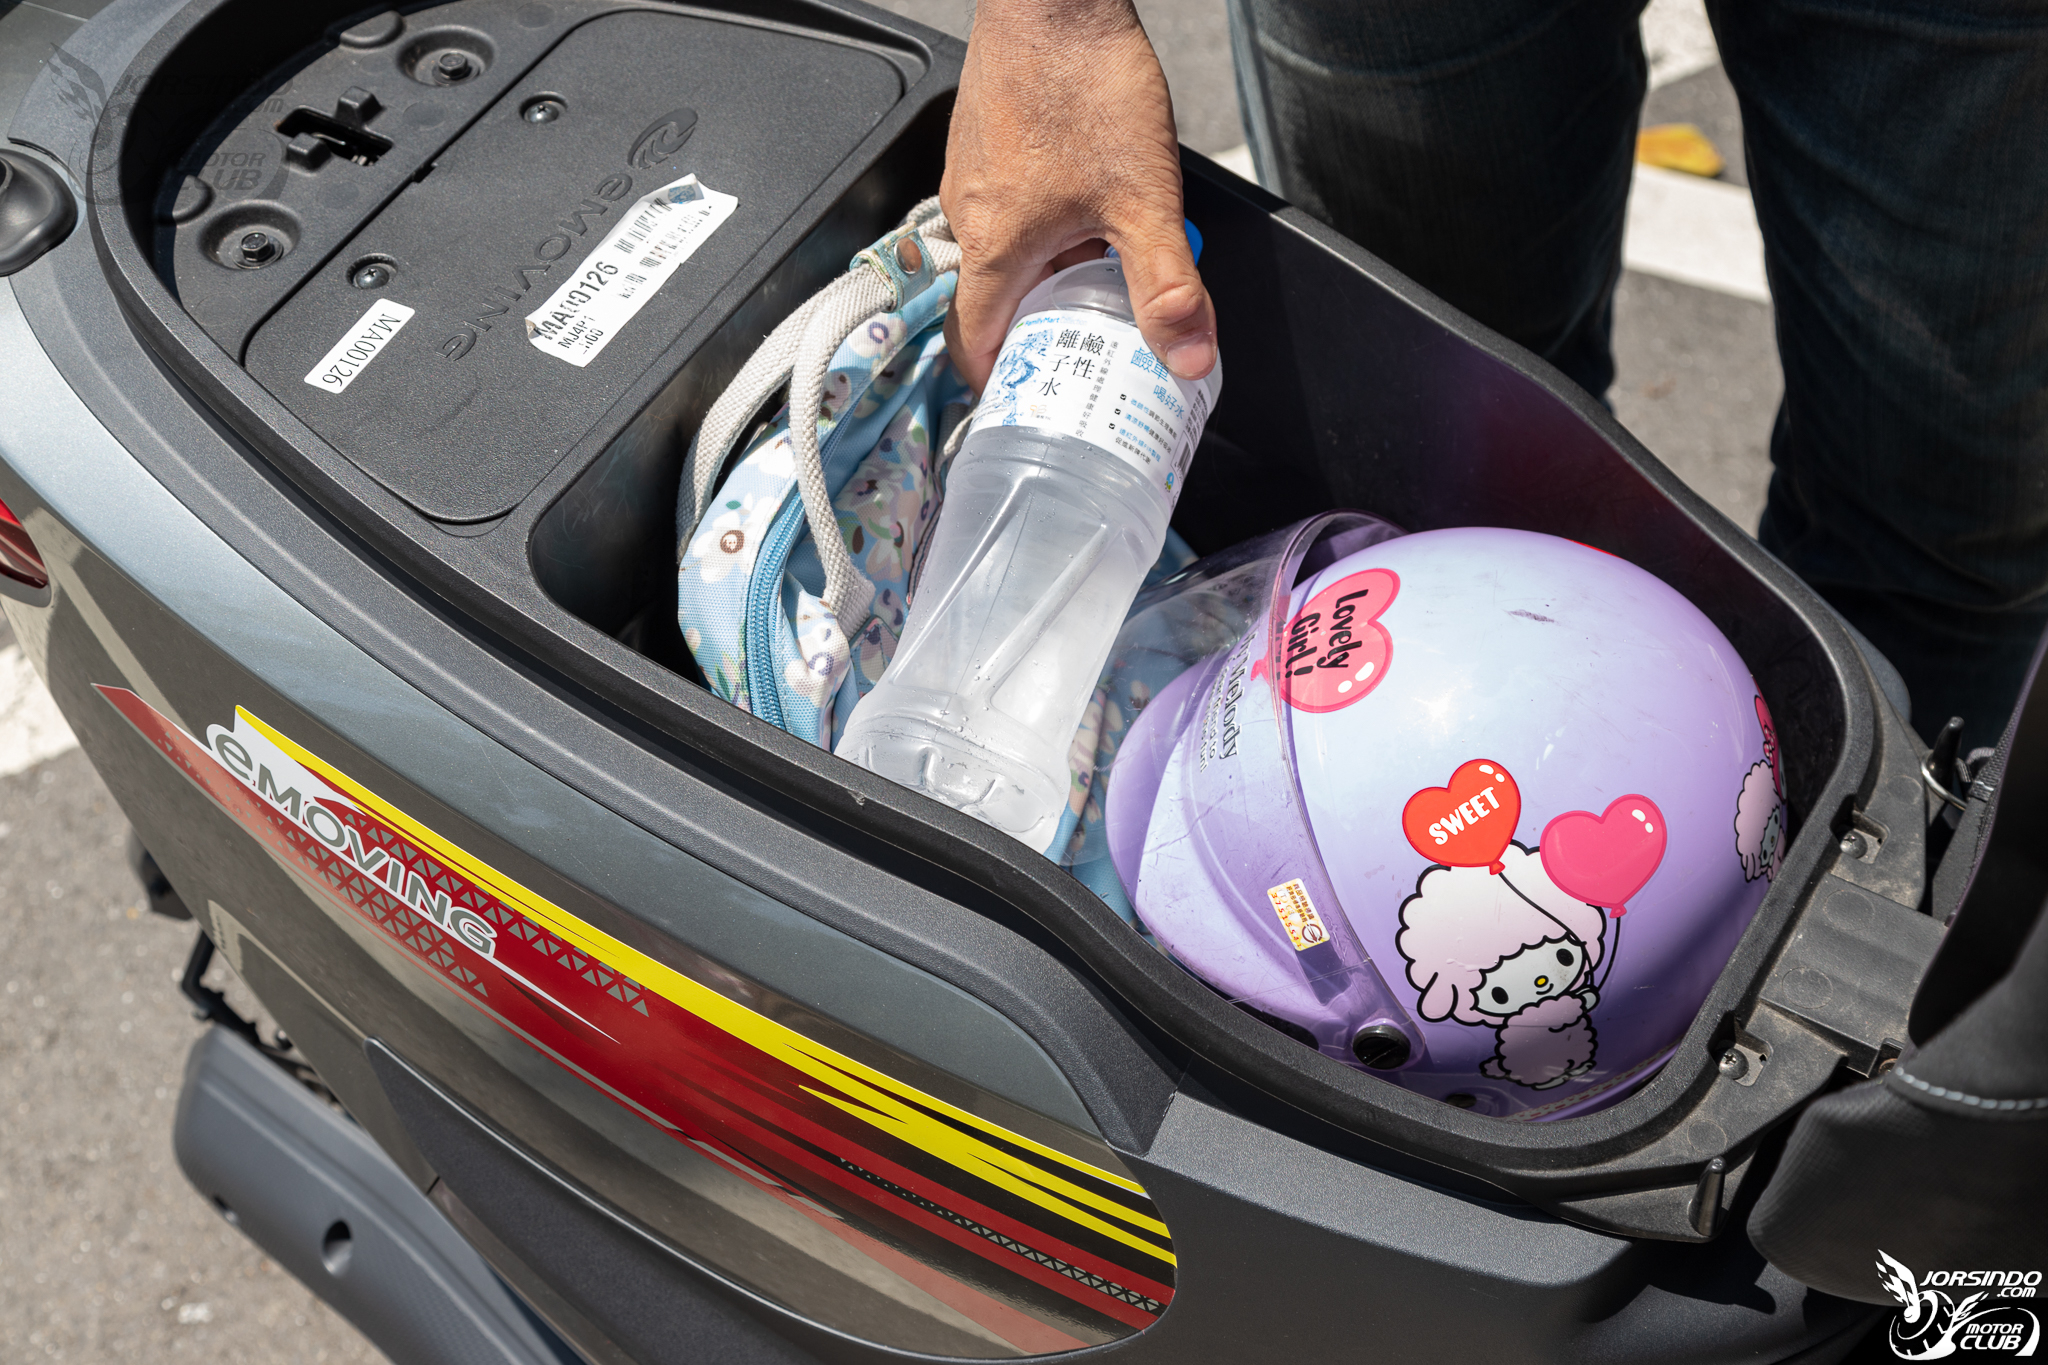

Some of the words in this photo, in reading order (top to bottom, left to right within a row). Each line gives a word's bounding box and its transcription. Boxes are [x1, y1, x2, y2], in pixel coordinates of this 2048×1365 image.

[322, 313, 402, 387] MA00126
[1037, 329, 1081, 396] 離子水
[1153, 385, 1185, 419] 喝好水
[1284, 612, 1321, 678] Girl!
[1316, 588, 1369, 669] Lovely
[1219, 652, 1251, 760] Melody
[214, 733, 497, 956] eMOVING
[1429, 787, 1500, 845] SWEET
